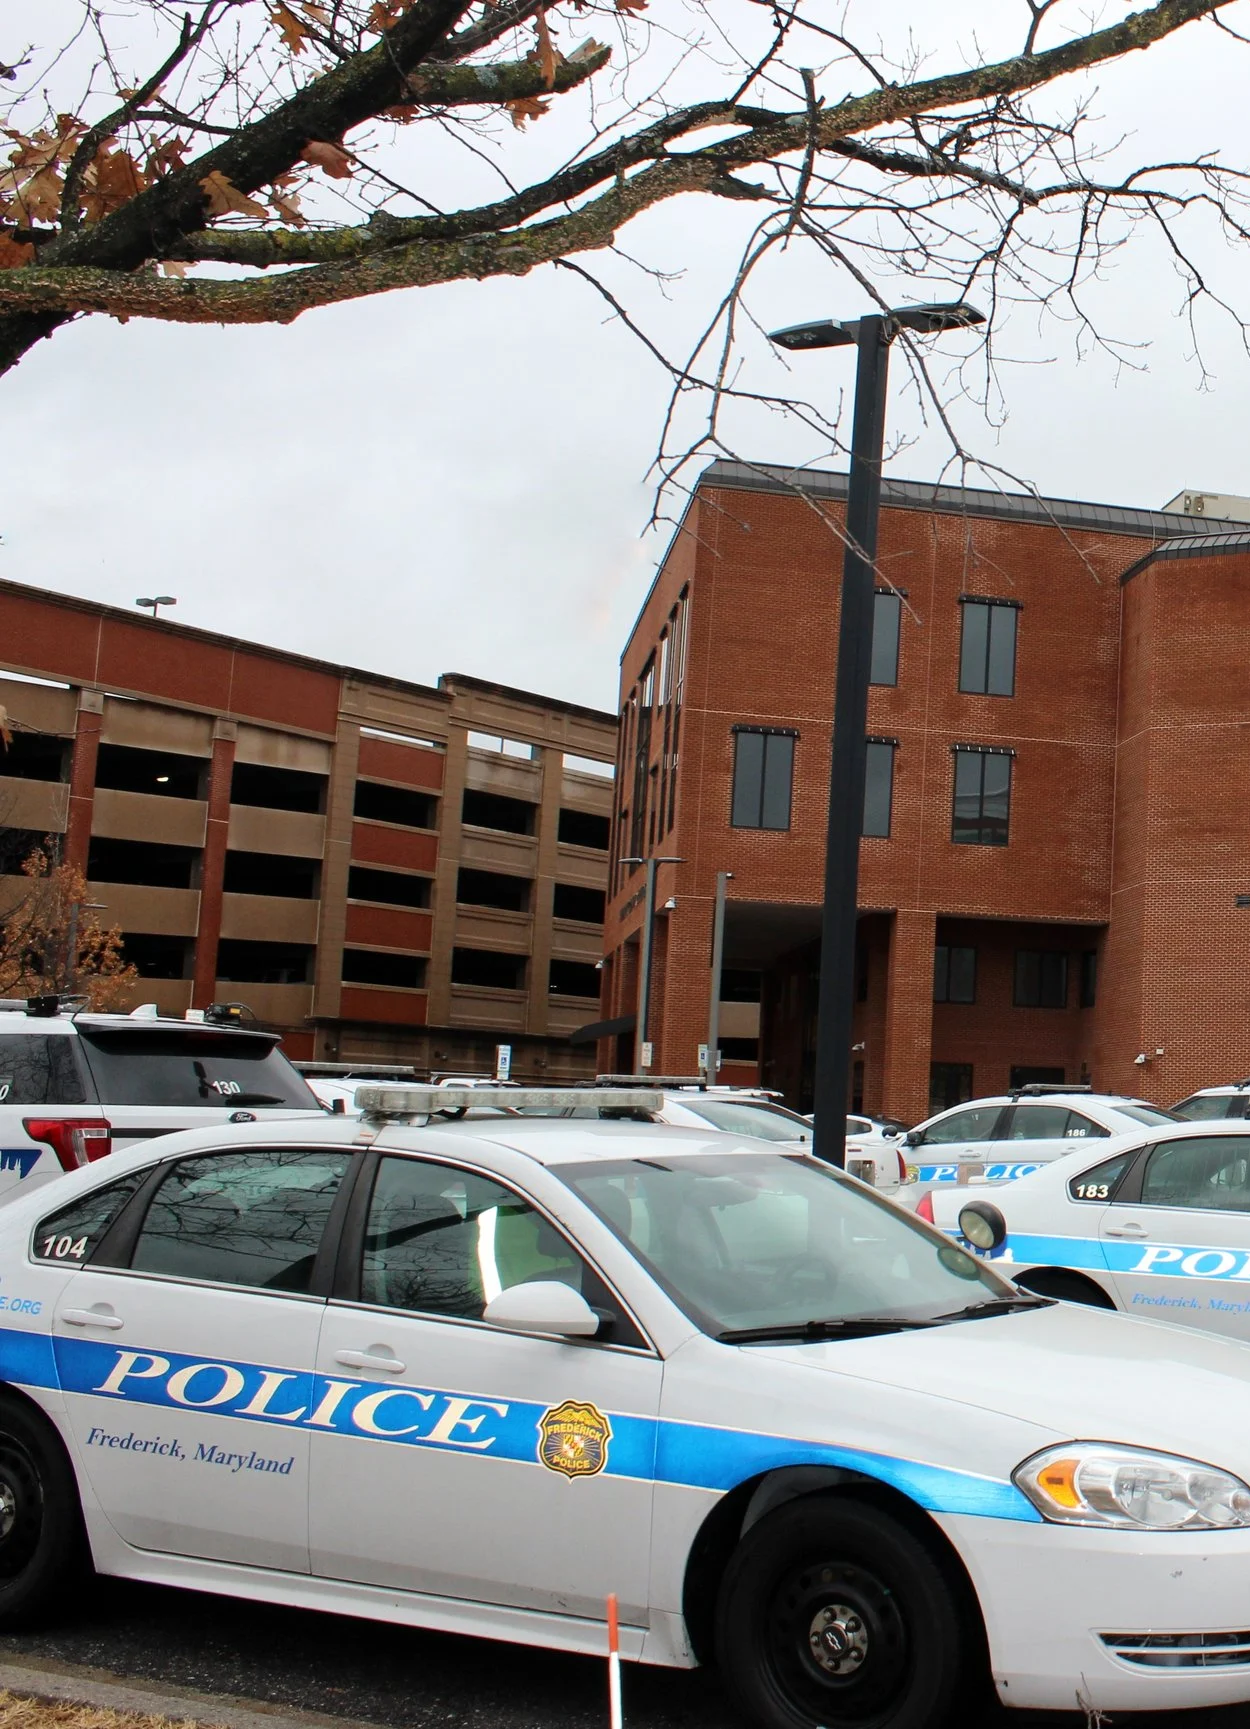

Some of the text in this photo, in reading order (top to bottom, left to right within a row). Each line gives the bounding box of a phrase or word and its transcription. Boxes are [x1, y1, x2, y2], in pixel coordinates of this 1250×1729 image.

[212, 1080, 241, 1095] 130
[1067, 1128, 1086, 1137] 186
[1076, 1184, 1109, 1198] 183
[43, 1234, 89, 1259] 104
[1131, 1292, 1202, 1310] Frederick,
[92, 1350, 509, 1450] POLICE
[546, 1422, 603, 1443] FREDERICK
[86, 1427, 295, 1475] Frederick, Maryland
[552, 1455, 592, 1469] POLICE
